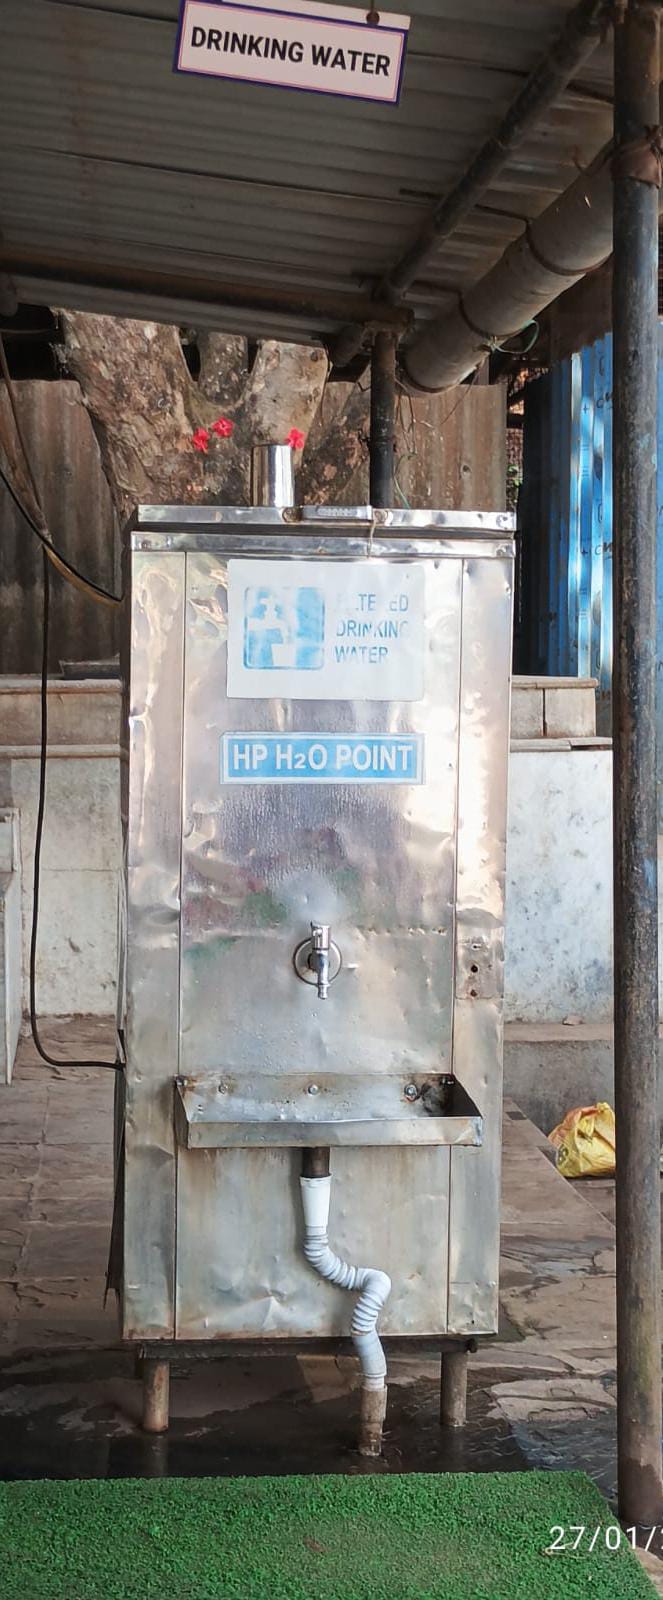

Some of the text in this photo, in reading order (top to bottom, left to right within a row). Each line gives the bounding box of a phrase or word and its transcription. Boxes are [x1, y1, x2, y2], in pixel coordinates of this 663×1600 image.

[191, 26, 390, 77] DRINKING WATER
[337, 593, 409, 612] TEED
[232, 743, 268, 770] HP
[335, 743, 413, 771] POINT
